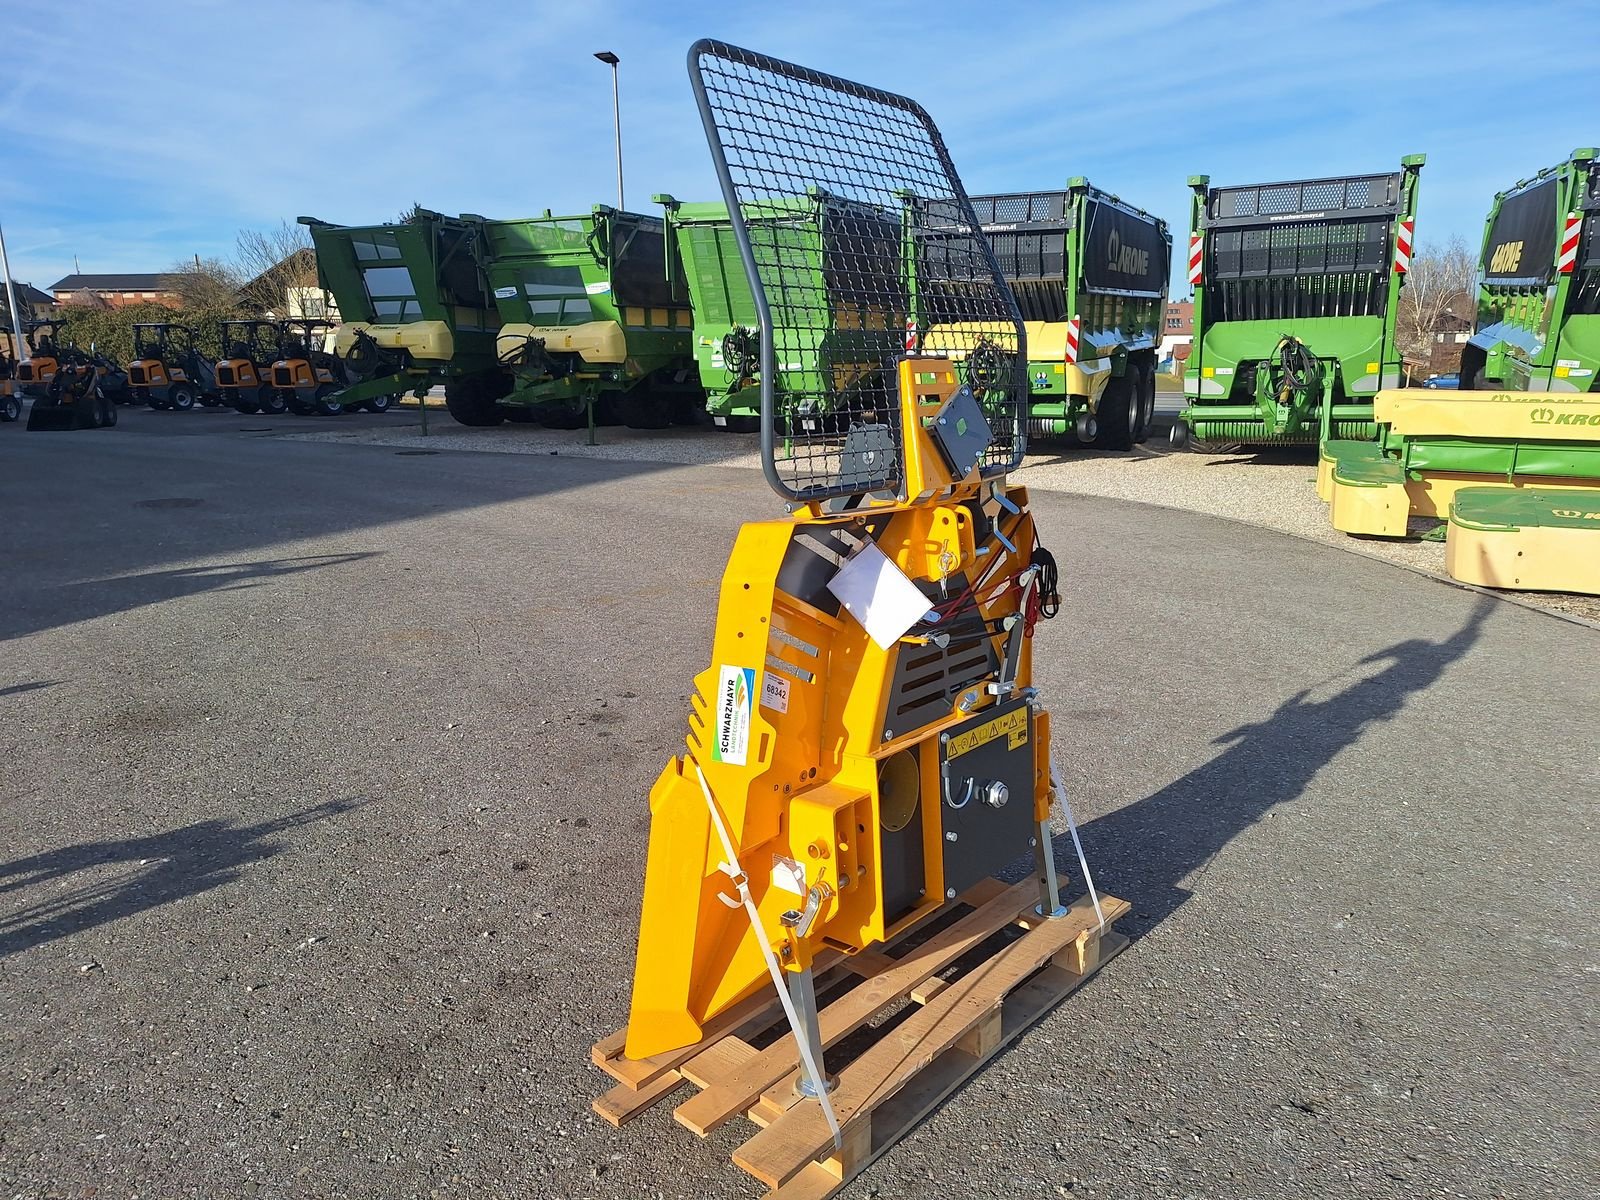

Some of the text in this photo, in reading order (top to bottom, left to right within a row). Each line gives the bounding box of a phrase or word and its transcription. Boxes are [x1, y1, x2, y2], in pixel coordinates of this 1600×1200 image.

[1117, 244, 1149, 276] KRONE
[766, 683, 787, 700] 68342
[721, 679, 735, 754] SCHWARZMAYR
[730, 710, 740, 754] LANDTECHNIK
